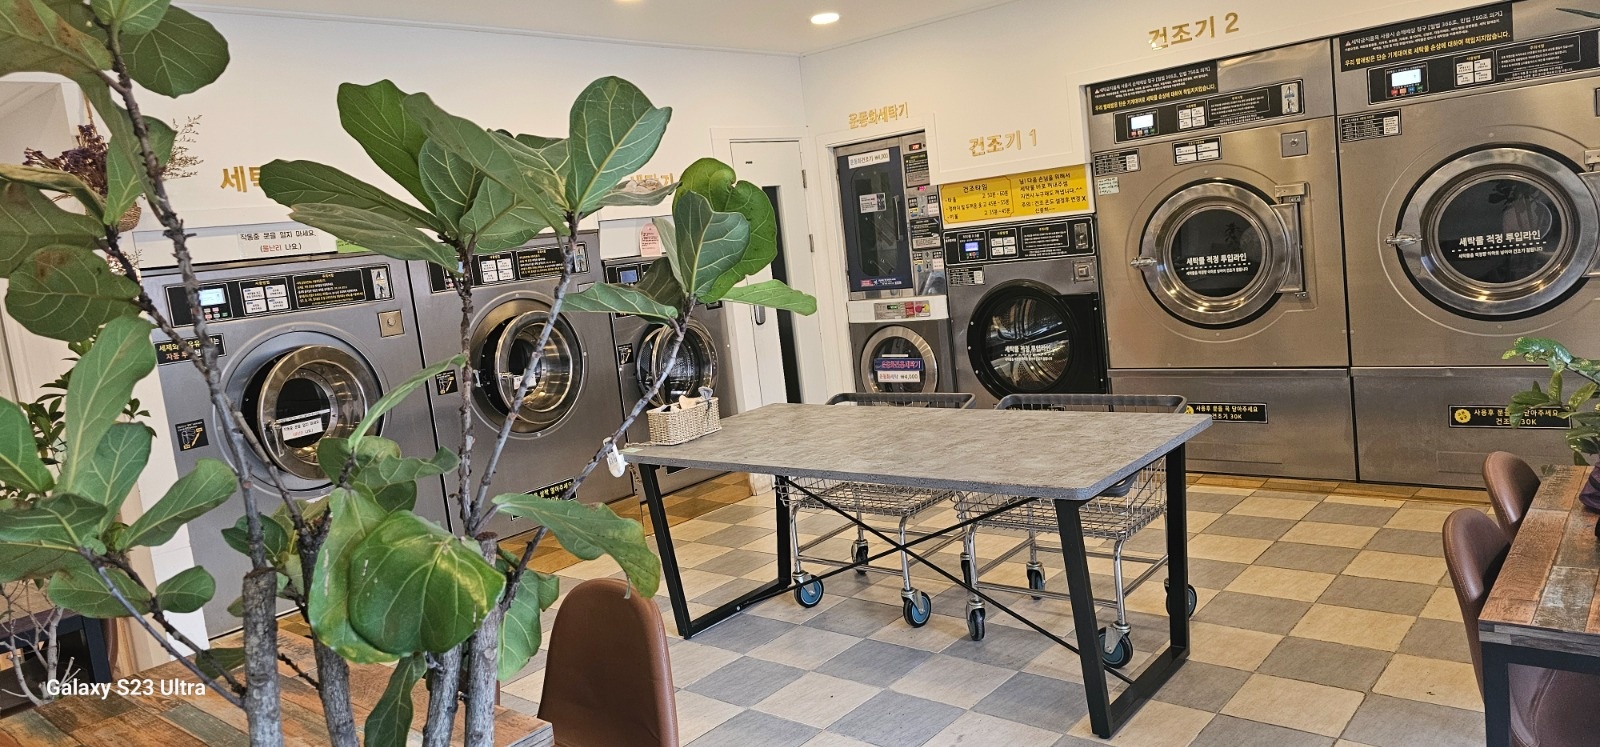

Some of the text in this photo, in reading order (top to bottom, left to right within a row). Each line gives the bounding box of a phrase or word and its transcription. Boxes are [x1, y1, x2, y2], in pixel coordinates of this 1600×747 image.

[1148, 12, 1239, 50] 건조기 2
[1356, 55, 1375, 65] 빨래방은
[1376, 53, 1386, 61] 단순
[1388, 48, 1413, 58] 기계대여로
[1414, 44, 1429, 54] 세탁물
[1430, 42, 1446, 50] 손상에
[1448, 38, 1464, 47] 대하여
[1464, 31, 1510, 44] 책임지지않습니다.
[849, 101, 908, 129] 운동화세탁기
[969, 129, 1036, 157] 건조기 1
[963, 184, 987, 193] 건조타임
[260, 244, 282, 252] (물난리
[1459, 230, 1540, 246] 세탁물 적정 투입라인
[1186, 253, 1246, 266] 세탁물 적정 투입라인
